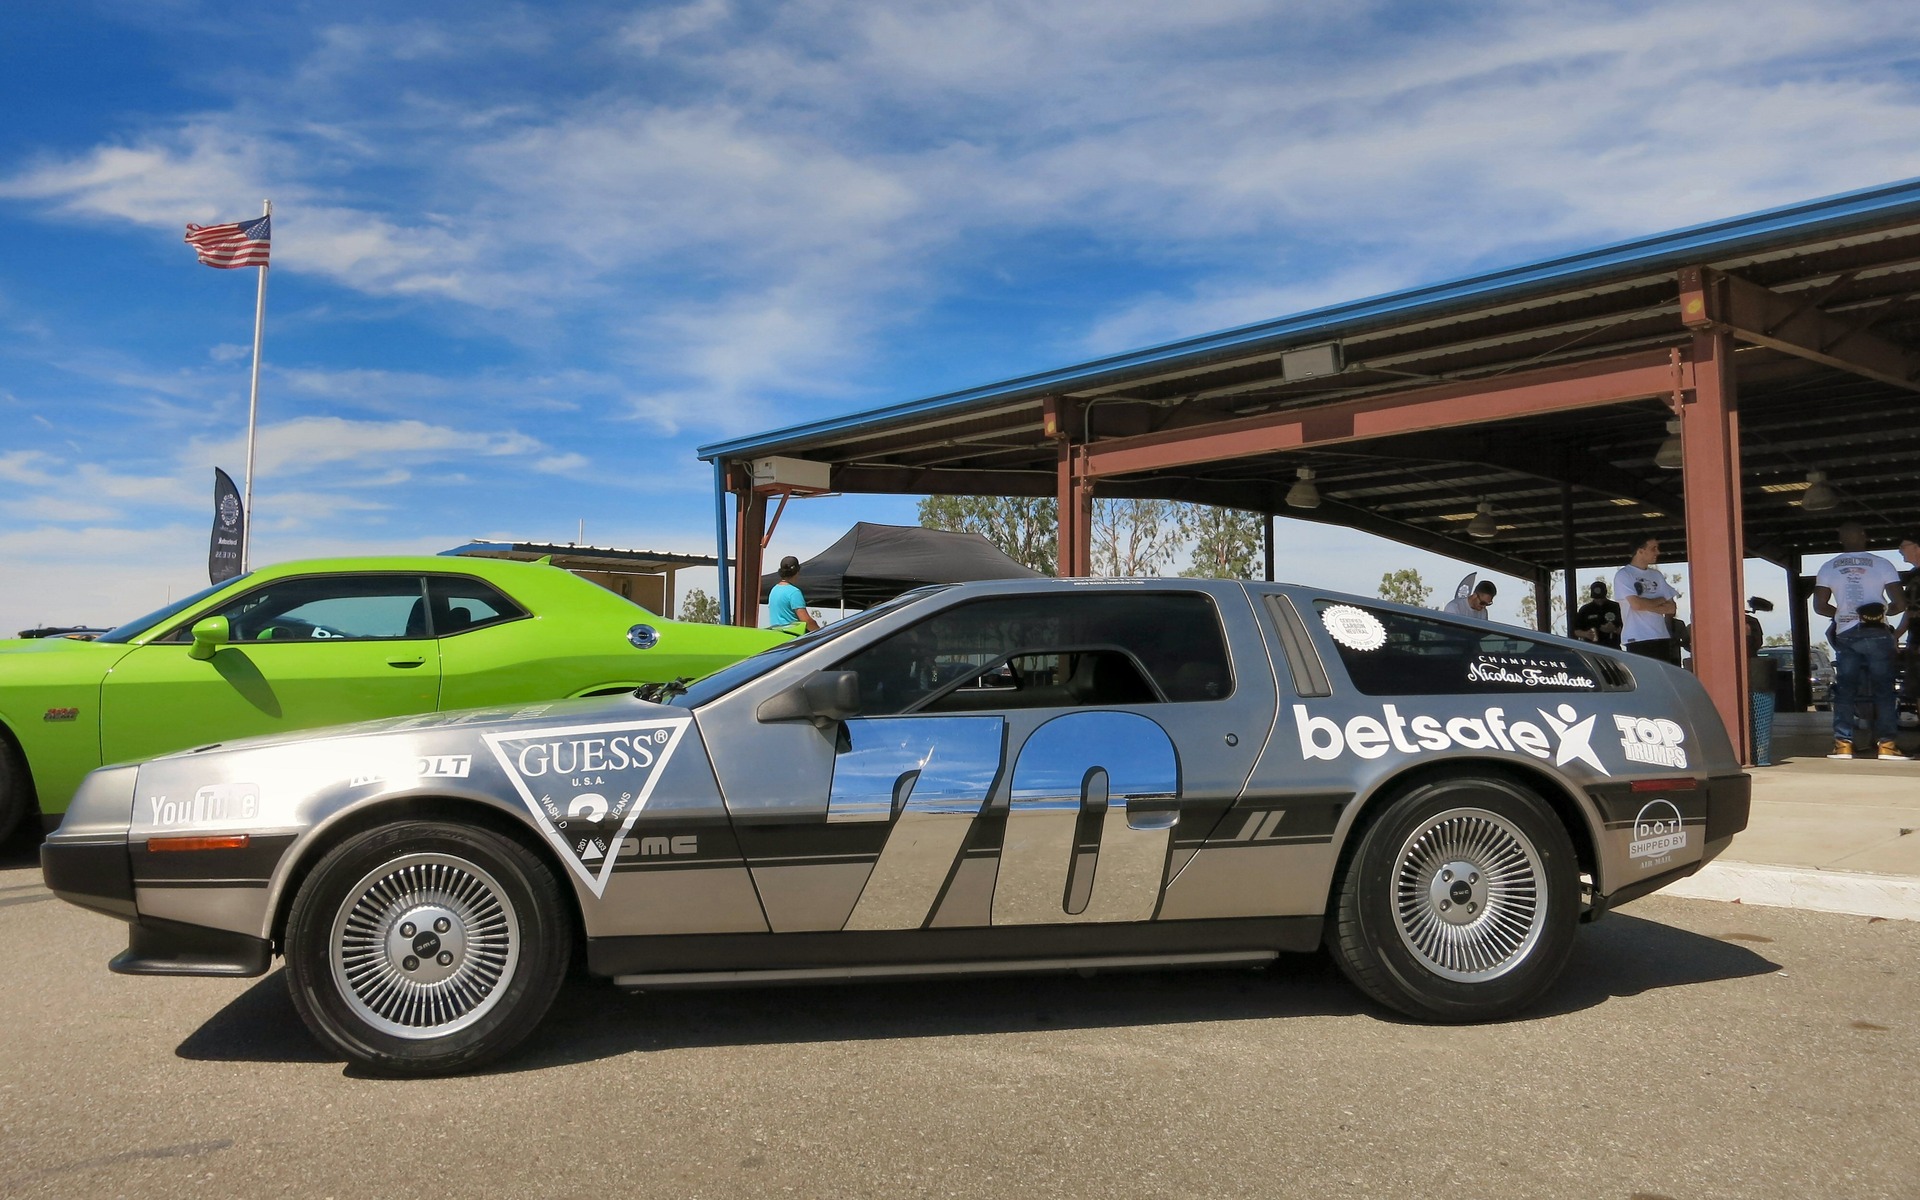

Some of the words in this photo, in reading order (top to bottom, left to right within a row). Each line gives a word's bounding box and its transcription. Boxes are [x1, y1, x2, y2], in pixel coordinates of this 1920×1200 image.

[1468, 662, 1523, 683] Nicolas
[1521, 668, 1595, 688] Feuillatte
[1478, 655, 1568, 669] CHAMPAGNE
[1293, 704, 1551, 760] betsafe
[1613, 714, 1685, 747] TOP
[1621, 739, 1687, 768] TRUMPS
[151, 790, 256, 826] YouTue
[611, 791, 632, 820] JEANS
[826, 709, 1183, 931] 70
[1630, 838, 1672, 855] SHIPPED
[1672, 834, 1685, 847] BY
[1640, 859, 1653, 869] AIR
[1654, 855, 1672, 866] MAIL
